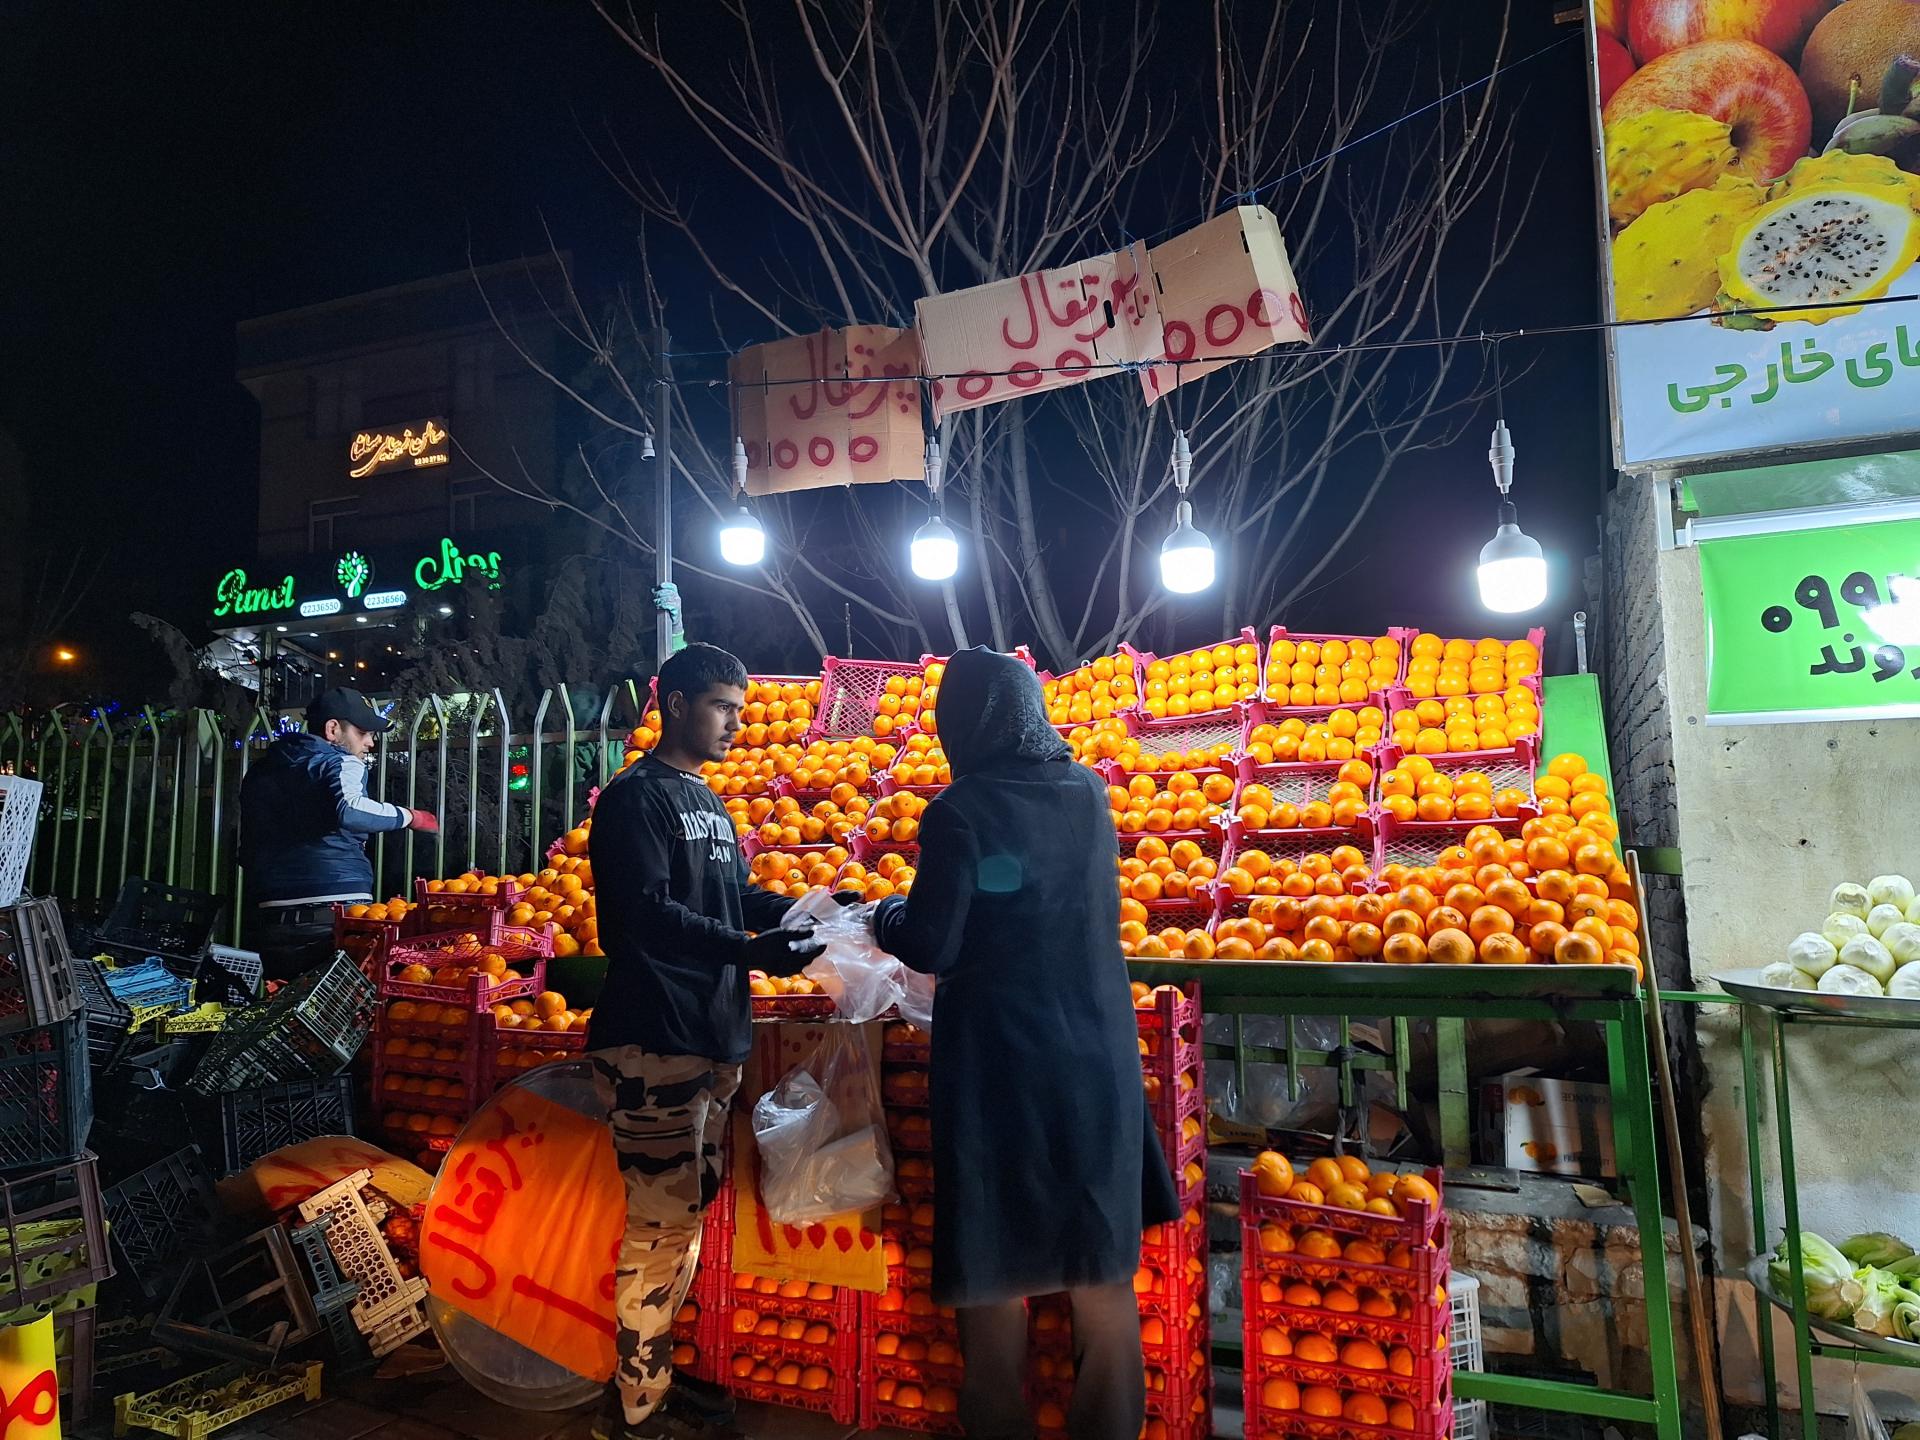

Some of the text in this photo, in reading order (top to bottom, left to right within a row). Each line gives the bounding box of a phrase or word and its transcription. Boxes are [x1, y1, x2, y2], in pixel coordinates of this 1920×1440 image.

[1667, 338, 1835, 413] خارجی
[302, 602, 339, 614] 22336550
[366, 594, 404, 606] 22336560
[709, 842, 731, 863] JAN
